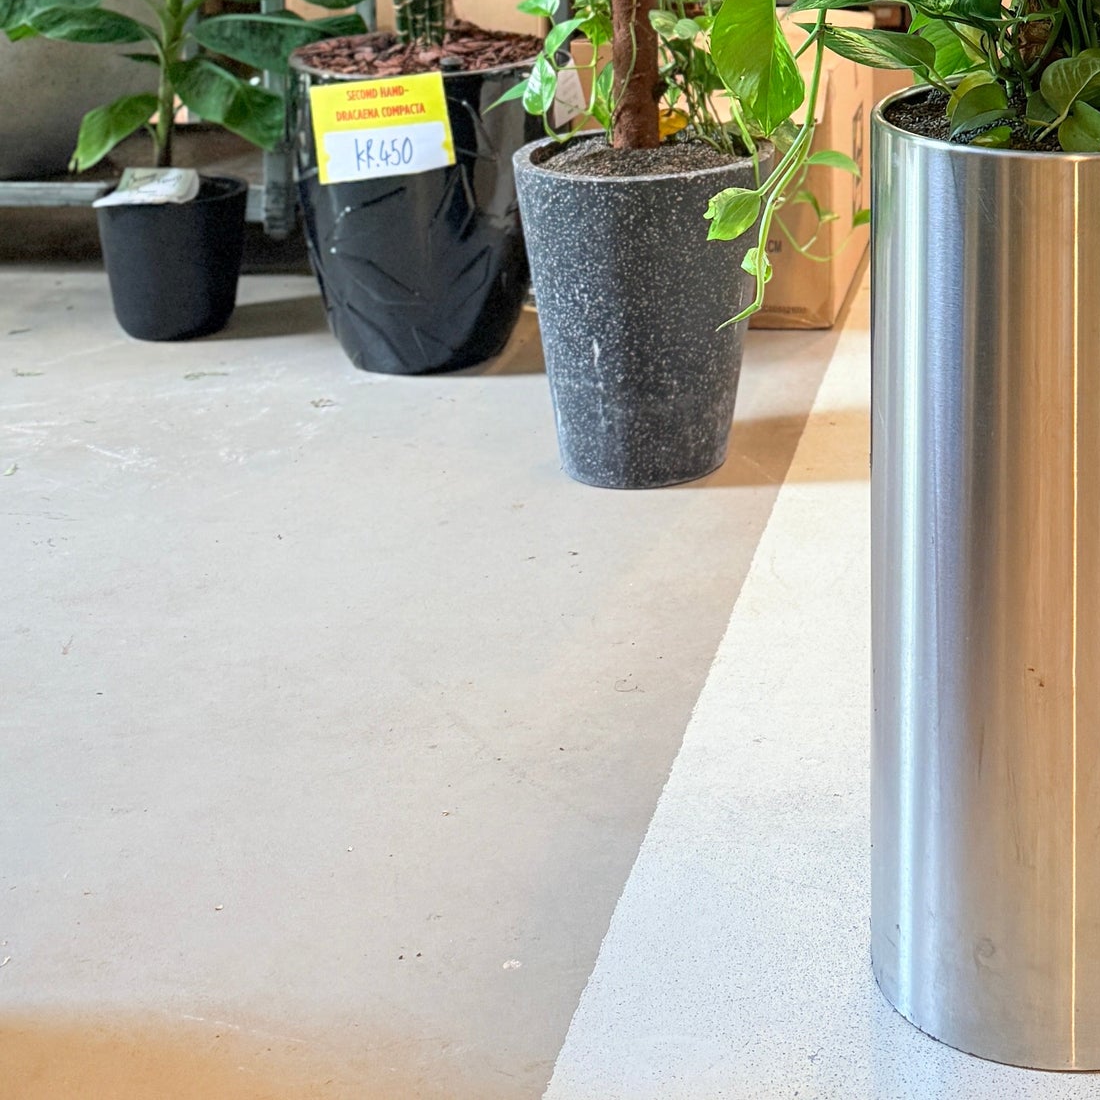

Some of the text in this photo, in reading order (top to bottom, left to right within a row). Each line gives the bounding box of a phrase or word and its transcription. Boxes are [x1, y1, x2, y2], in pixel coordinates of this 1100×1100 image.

[346, 85, 409, 101] SECOND HAND-
[336, 103, 426, 122] DRACAENA COMPACTA
